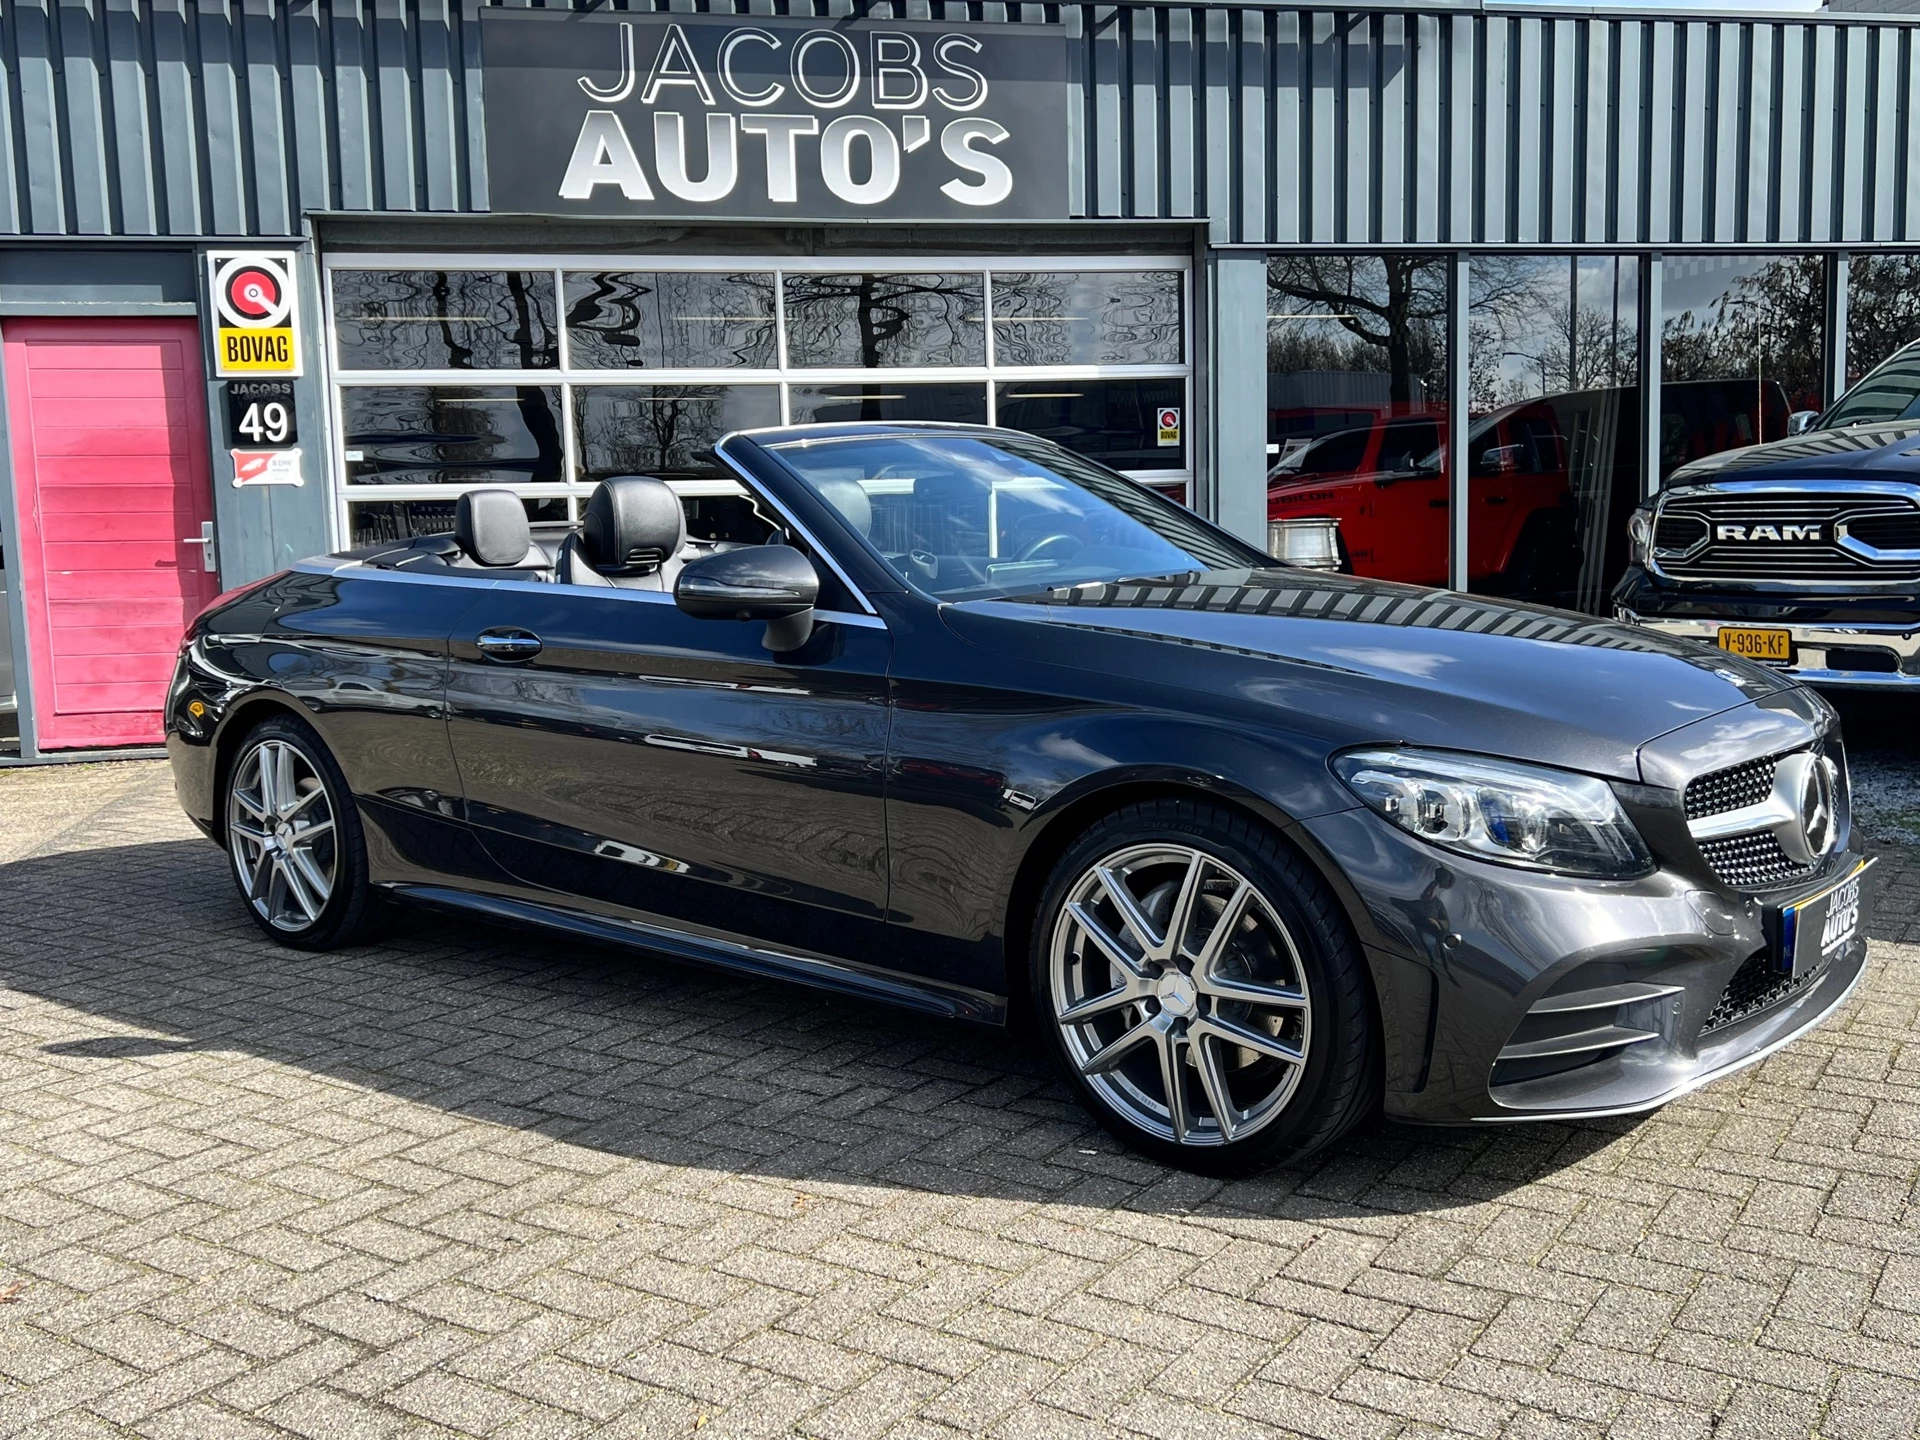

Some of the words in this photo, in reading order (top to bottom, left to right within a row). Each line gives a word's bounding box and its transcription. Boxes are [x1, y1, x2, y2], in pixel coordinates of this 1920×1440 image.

[577, 22, 988, 112] JACOBS
[558, 110, 1013, 206] AUTO'S
[226, 335, 289, 363] BOVAG
[230, 383, 291, 395] JACOBS
[239, 402, 288, 442] 49
[1160, 430, 1177, 439] BOVAG
[1717, 524, 1822, 541] RAM
[1724, 632, 1785, 656] V-936-KF
[1825, 876, 1860, 918] JACOBS
